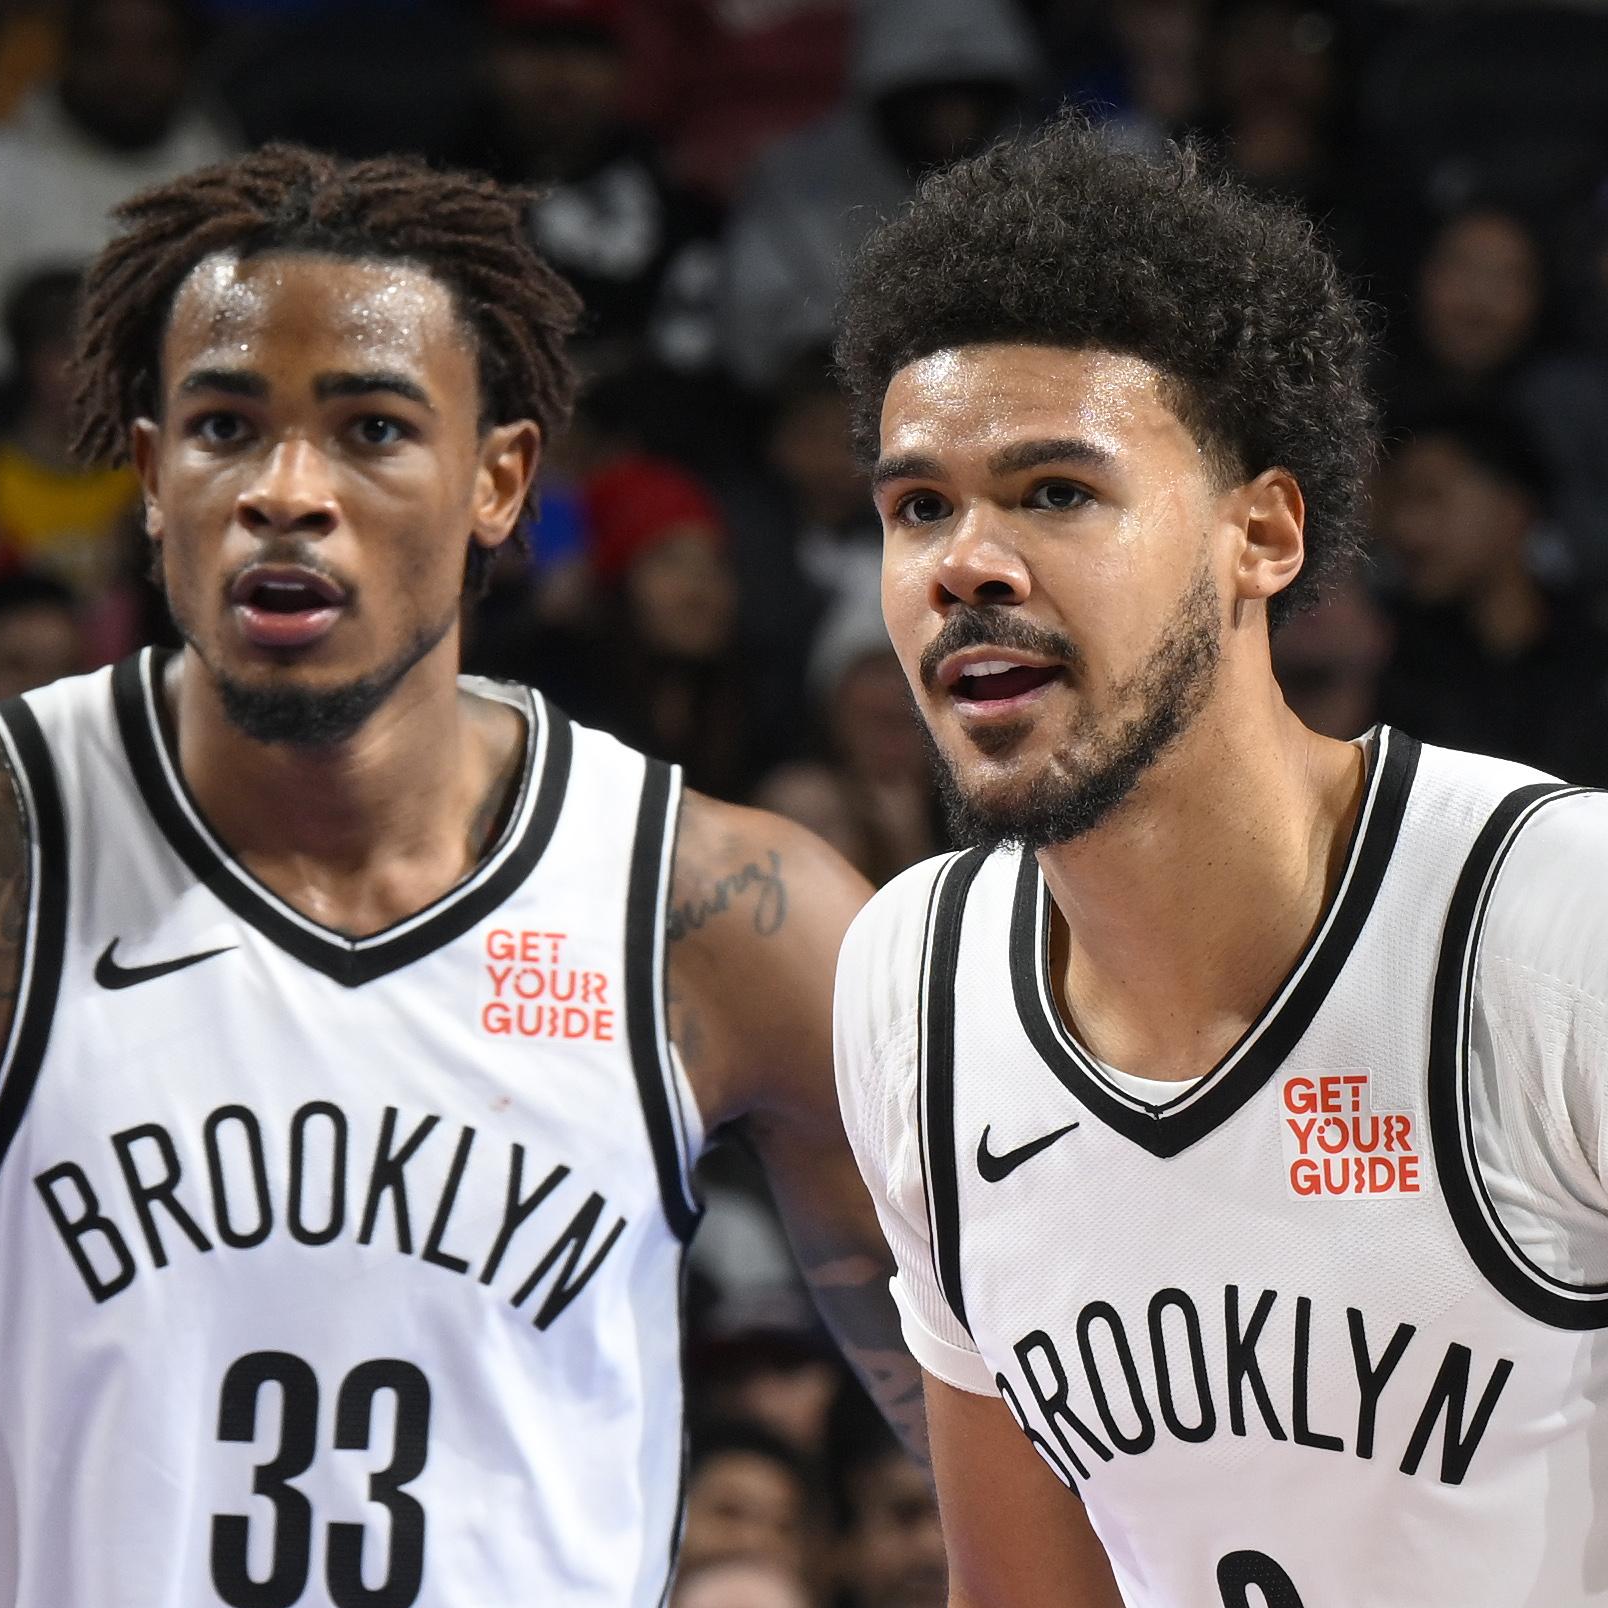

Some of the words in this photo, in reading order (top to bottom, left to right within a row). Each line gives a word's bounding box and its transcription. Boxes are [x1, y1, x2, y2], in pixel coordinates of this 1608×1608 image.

[485, 929, 567, 964] GET
[485, 964, 608, 1004] YOUR
[482, 1001, 614, 1041] GUIDE
[1282, 1075, 1368, 1114] GET
[1286, 1115, 1412, 1155] YOUR
[1289, 1156, 1421, 1196] GUIDE
[34, 1100, 627, 1332] BROOKLYN
